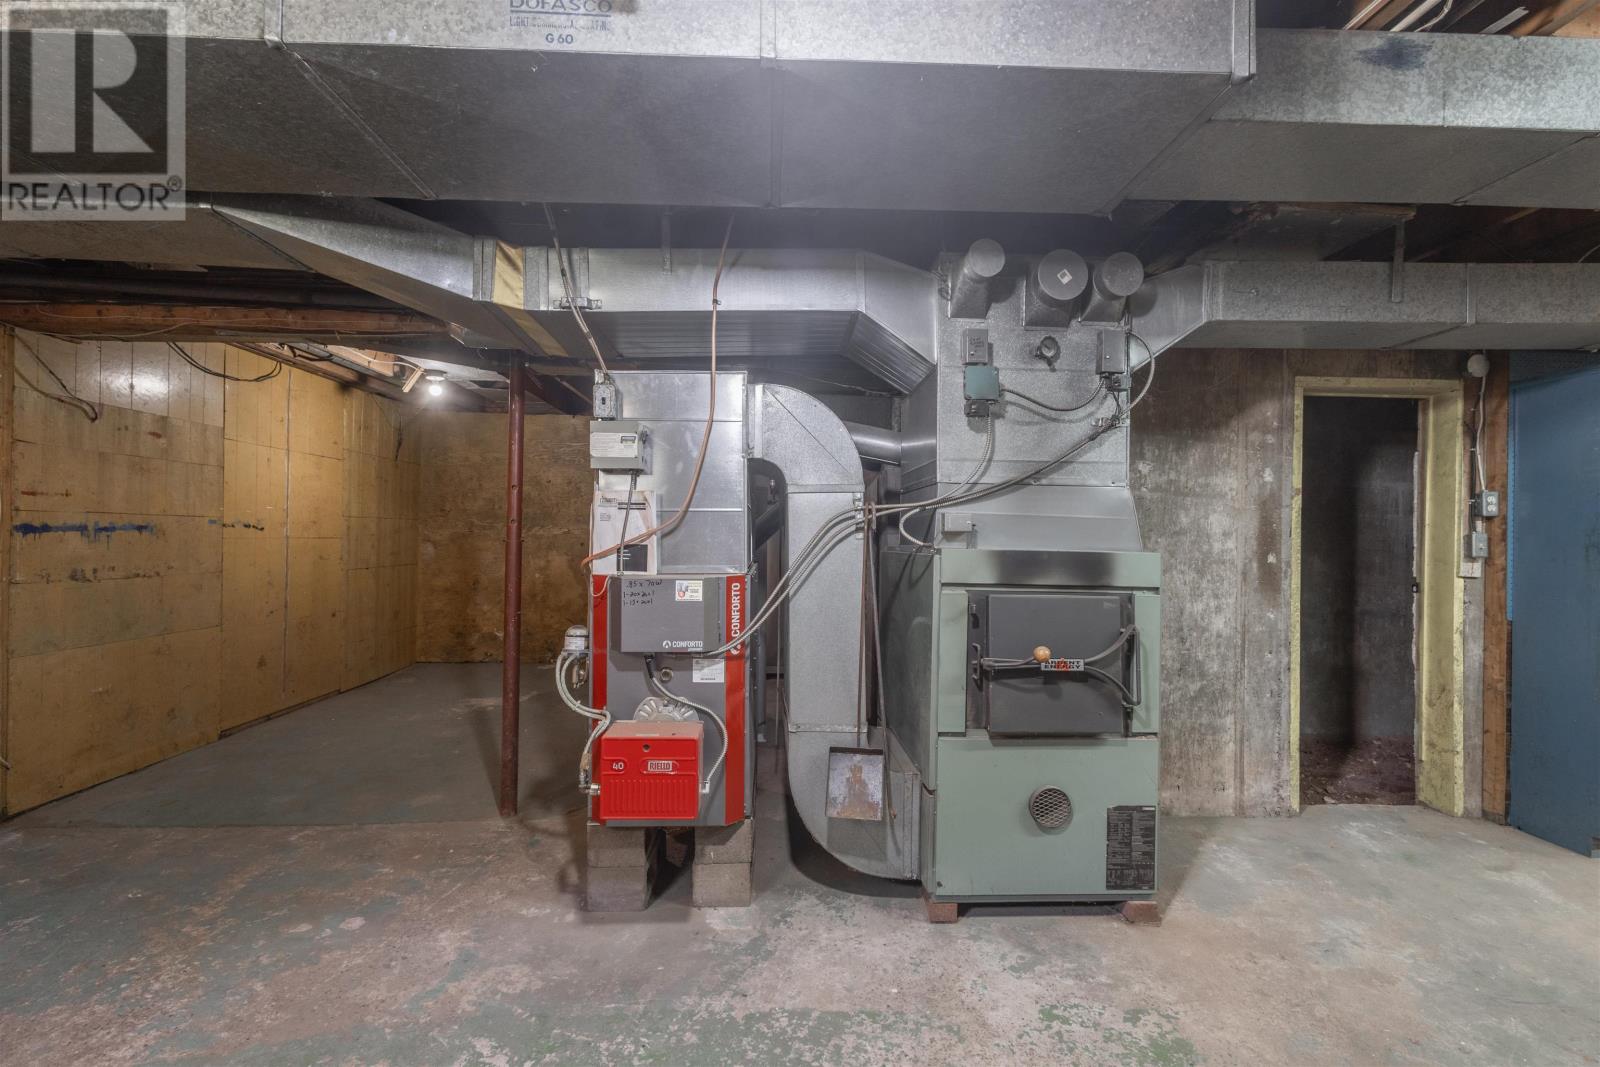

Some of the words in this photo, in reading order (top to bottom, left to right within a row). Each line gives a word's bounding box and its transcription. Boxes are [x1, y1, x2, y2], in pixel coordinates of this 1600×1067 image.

[510, 0, 612, 12] DOFASCO
[546, 33, 555, 44] G
[557, 34, 574, 44] 60
[731, 582, 741, 638] CONFORTO
[672, 640, 703, 648] CONFORTO
[612, 762, 624, 770] 40
[649, 762, 671, 771] RIELLO
